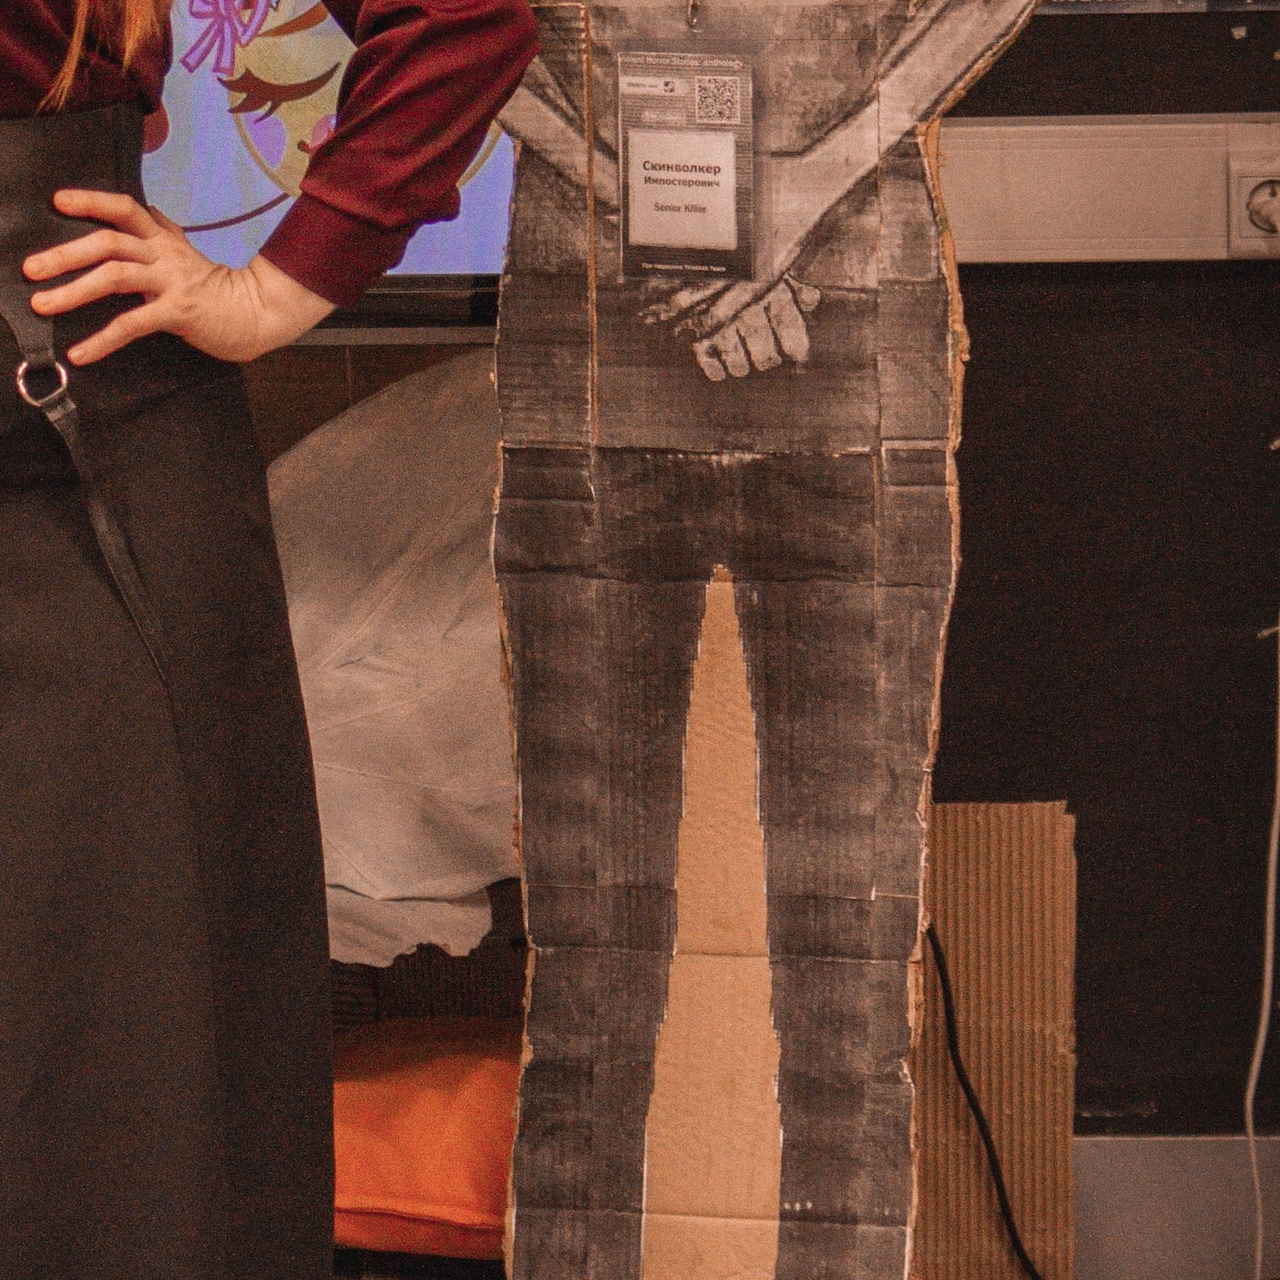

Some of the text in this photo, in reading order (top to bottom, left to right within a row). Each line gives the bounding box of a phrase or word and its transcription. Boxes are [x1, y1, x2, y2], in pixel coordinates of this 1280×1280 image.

[642, 160, 722, 176] Скинволкер
[643, 176, 721, 188] Импостерович
[654, 202, 707, 214] Senior Killer
